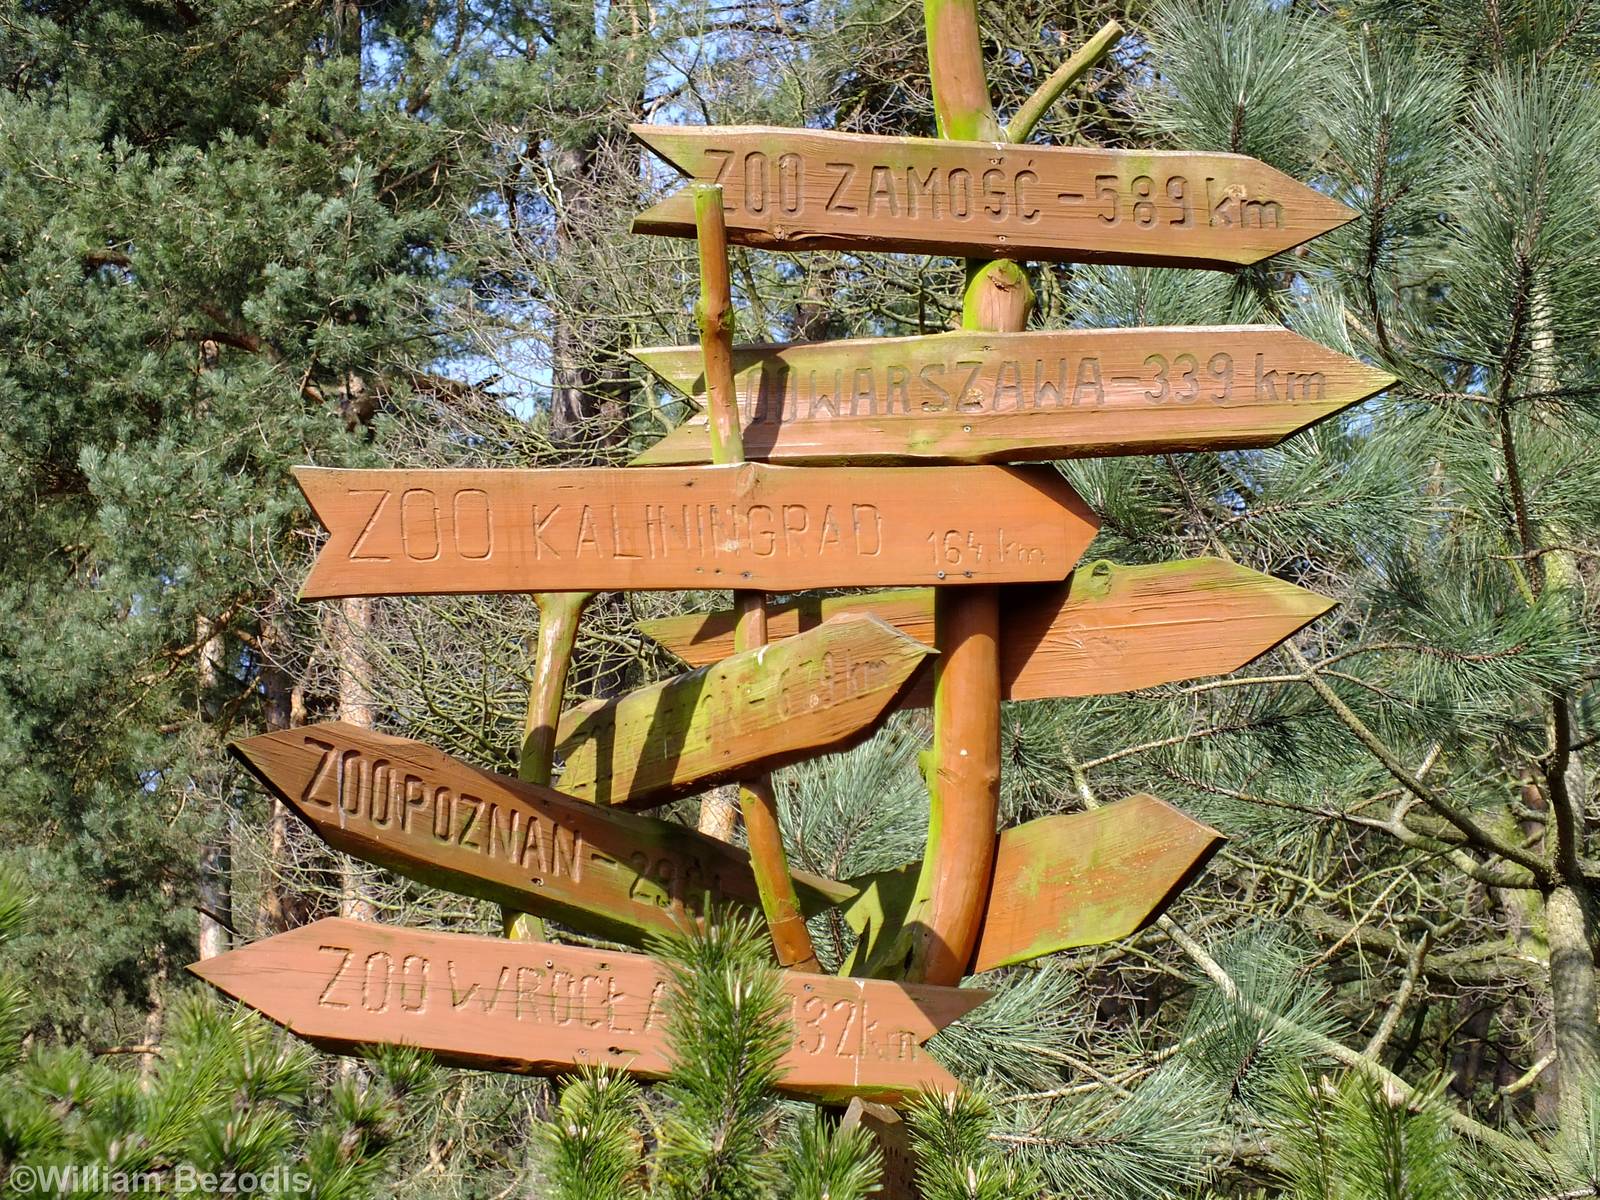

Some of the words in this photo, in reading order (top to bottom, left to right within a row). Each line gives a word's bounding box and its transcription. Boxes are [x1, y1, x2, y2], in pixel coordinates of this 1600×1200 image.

[703, 148, 804, 218] ZOO
[1204, 176, 1286, 230] km
[1254, 352, 1328, 402] km
[347, 487, 495, 563] ZOO
[531, 503, 884, 560] KALININGRAD
[926, 528, 984, 566] 164
[997, 527, 1047, 566] km
[301, 735, 399, 831] ZOO
[318, 944, 431, 1015] ZOO
[446, 959, 670, 1035] WROCŁA
